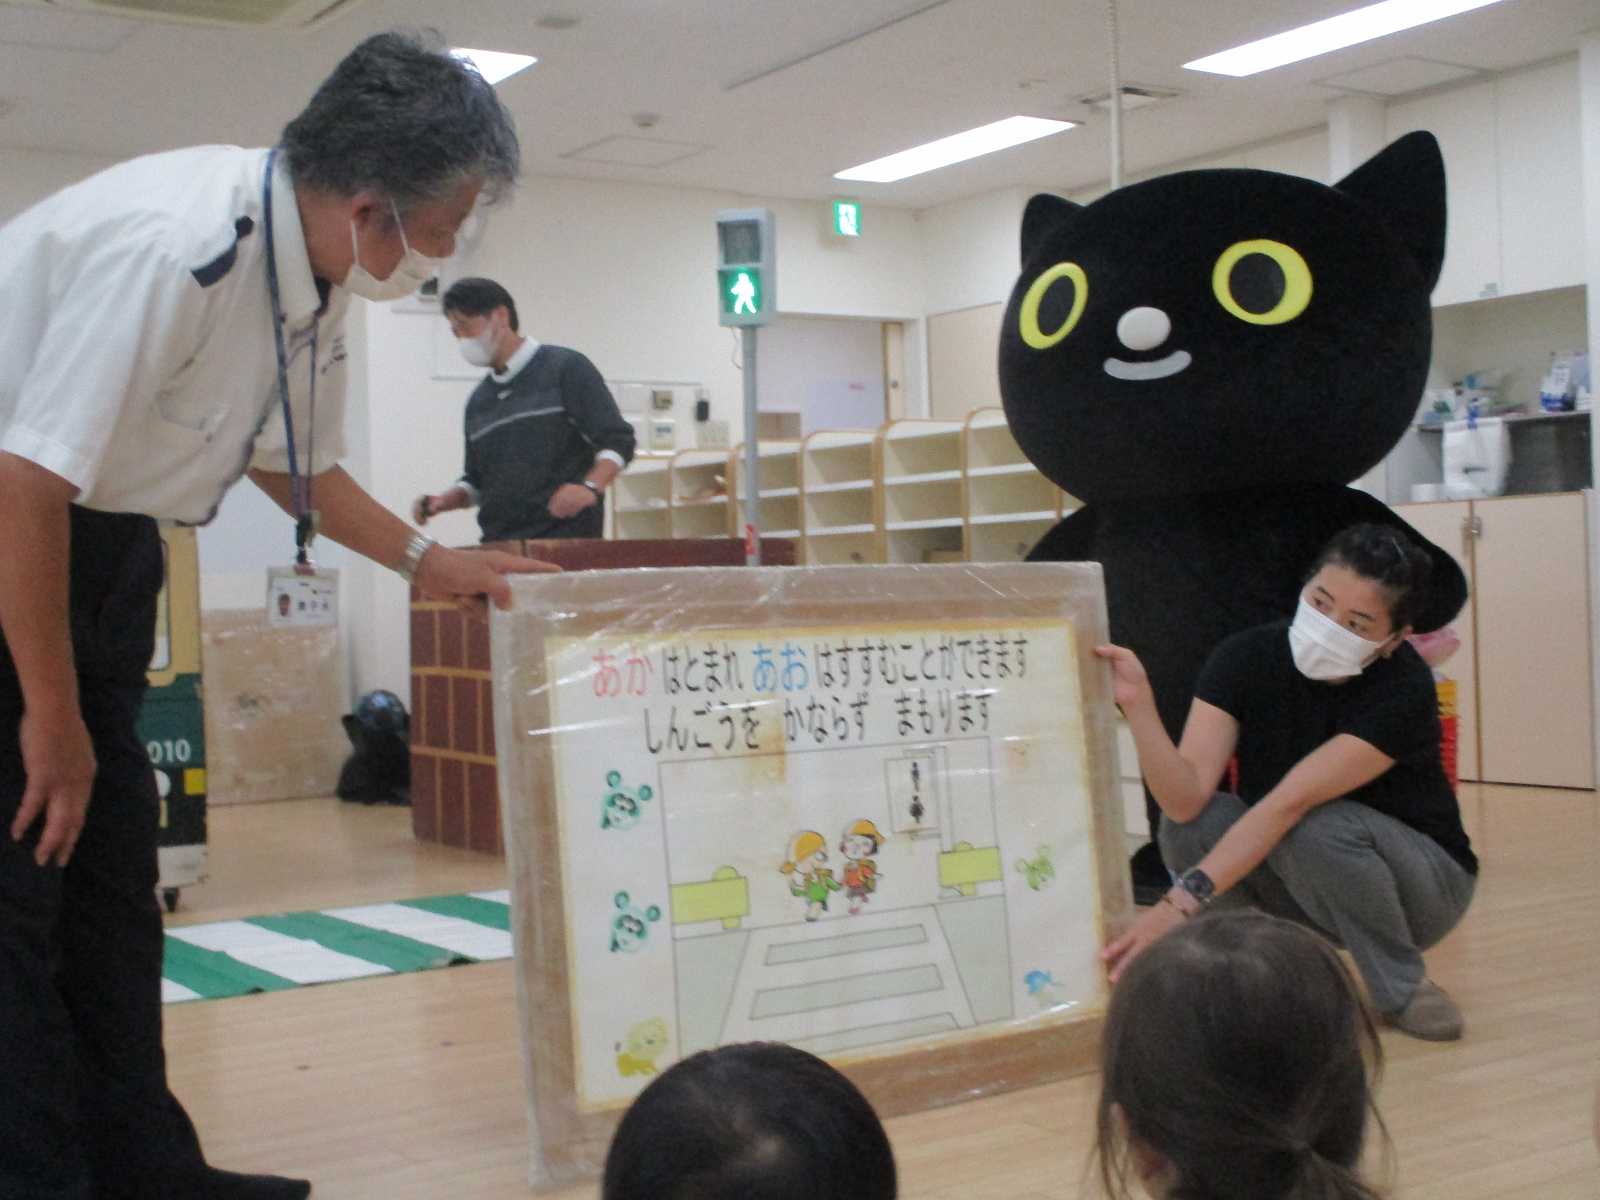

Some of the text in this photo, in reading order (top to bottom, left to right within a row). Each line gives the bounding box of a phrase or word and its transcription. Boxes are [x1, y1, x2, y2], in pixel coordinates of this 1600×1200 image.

[592, 632, 1028, 697] あか はとまれ あお はすすむことができます
[644, 685, 992, 754] しんごうを かならず まもります
